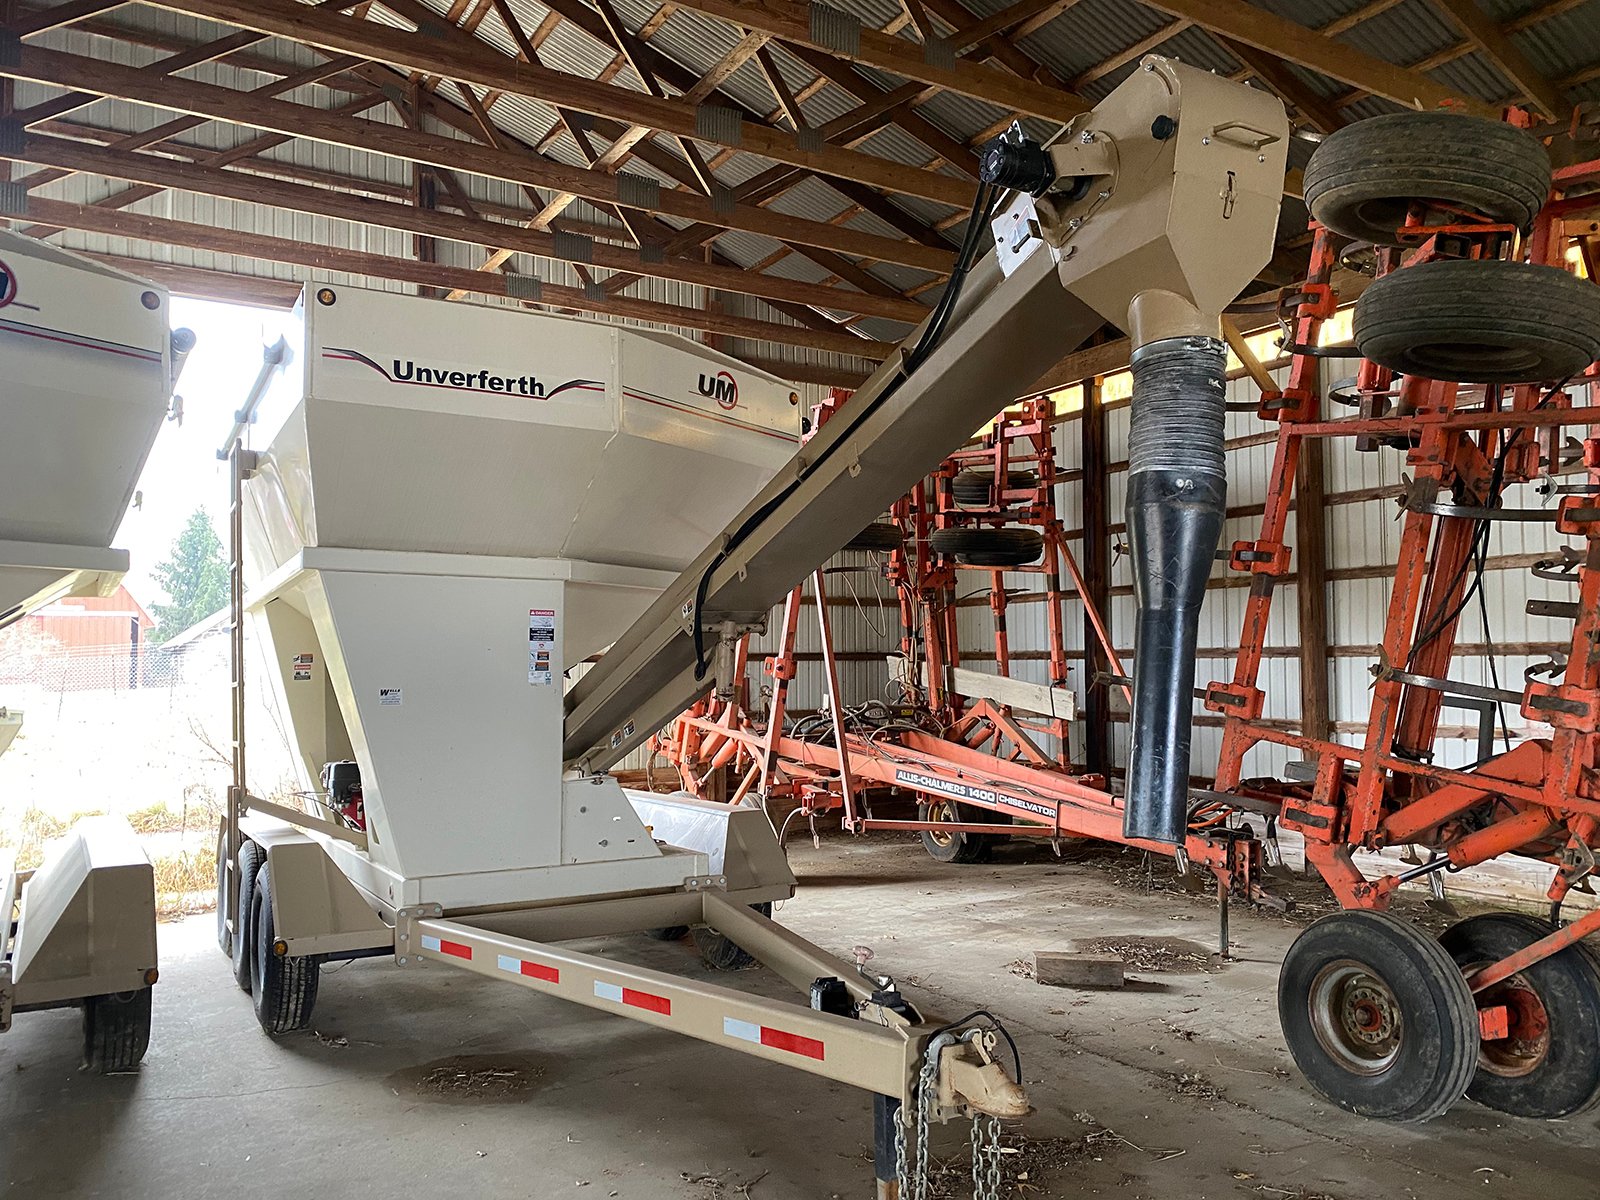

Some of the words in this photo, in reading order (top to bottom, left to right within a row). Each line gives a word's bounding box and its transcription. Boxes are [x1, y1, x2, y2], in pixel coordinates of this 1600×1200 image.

[393, 359, 545, 397] Unverferth
[698, 373, 735, 403] UM
[897, 770, 966, 795] ALLIS-CHALMERS
[968, 787, 996, 803] 1400
[999, 794, 1056, 818] CHISELVATOR
